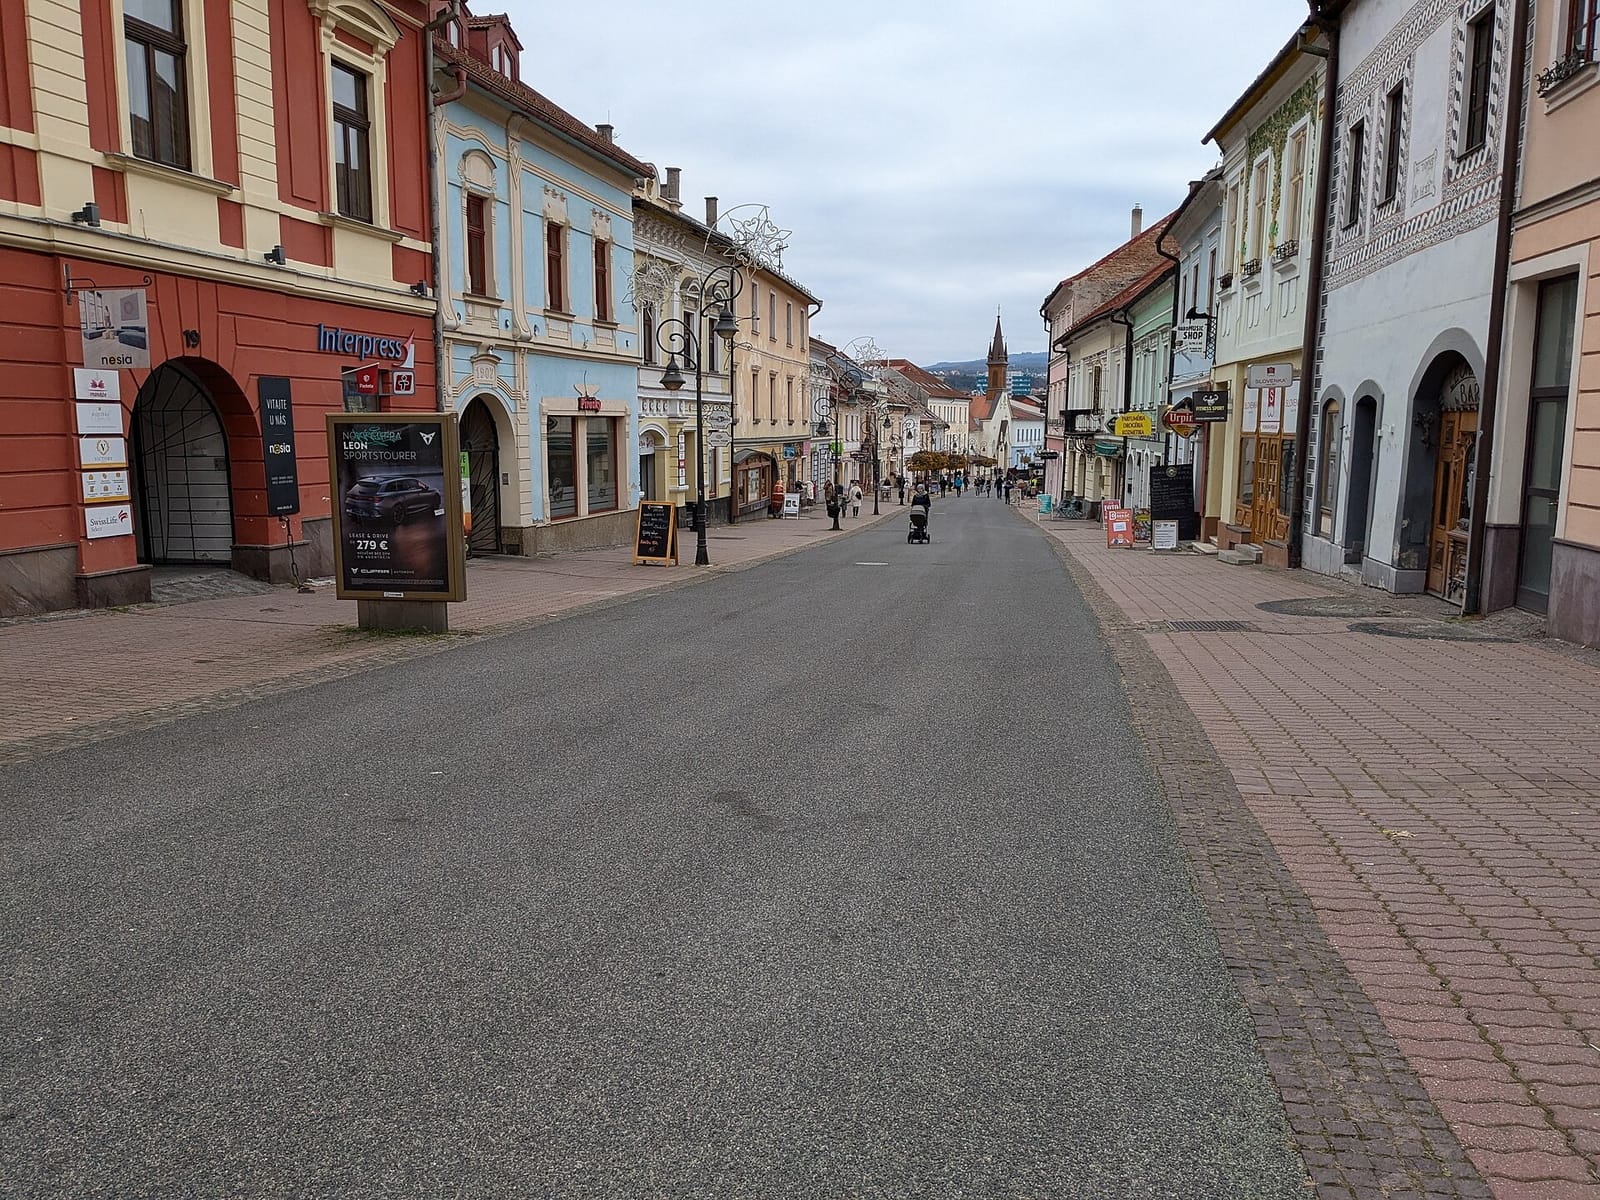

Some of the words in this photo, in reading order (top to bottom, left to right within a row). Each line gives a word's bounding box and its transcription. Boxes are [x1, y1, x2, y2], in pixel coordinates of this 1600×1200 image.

[183, 329, 200, 348] 19
[318, 323, 403, 361] Interpress
[101, 354, 132, 365] nesia
[1460, 383, 1480, 404] BAR
[266, 399, 287, 411] VITAJTE
[269, 415, 275, 426] U
[275, 412, 287, 426] NÁS
[269, 442, 291, 454] nesia
[343, 441, 368, 450] LEON
[343, 450, 417, 461] SPORTSTOURER
[356, 540, 377, 550] 279
[379, 540, 388, 550] €
